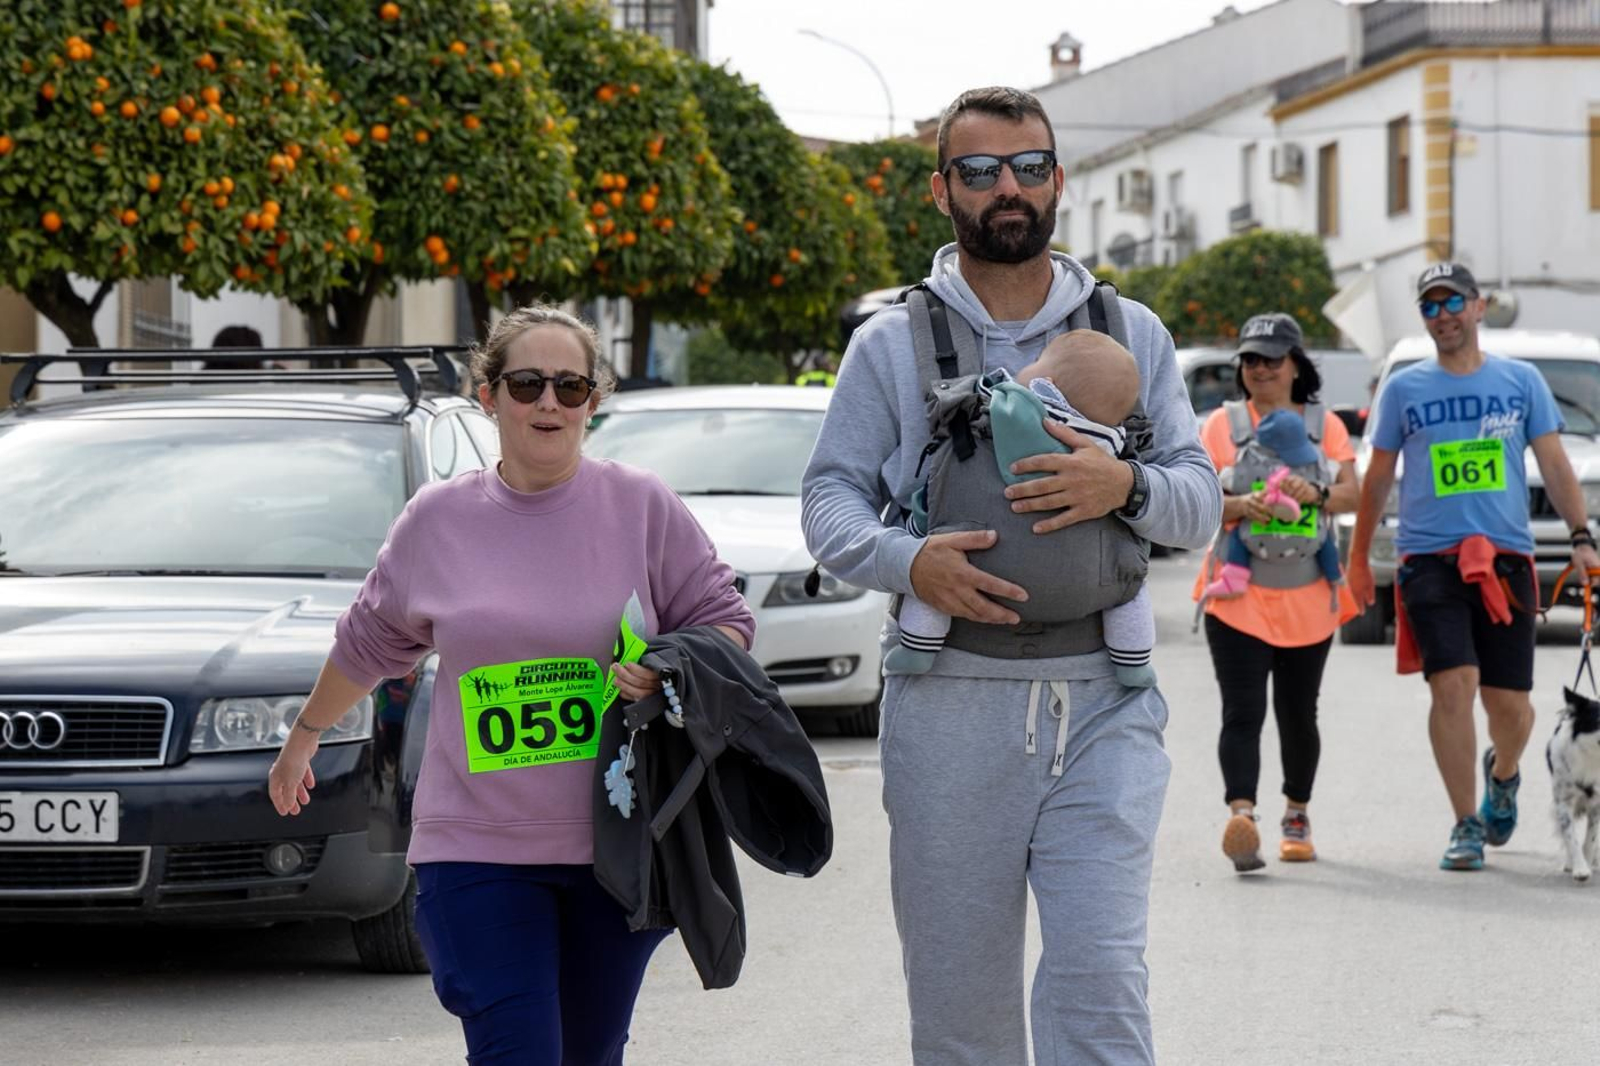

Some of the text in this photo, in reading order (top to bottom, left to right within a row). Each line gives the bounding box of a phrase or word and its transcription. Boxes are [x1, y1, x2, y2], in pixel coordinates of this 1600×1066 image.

[1402, 395, 1526, 439] ADIDAS
[1441, 458, 1497, 487] 061
[514, 670, 596, 686] RUNNING
[520, 662, 588, 674] CIRCUITO
[518, 682, 595, 697] Monte Lope Álvarez
[603, 685, 617, 706] ANDA
[477, 697, 596, 755] 059
[503, 748, 581, 766] DÍA DE ANDALUCÍA
[34, 799, 108, 833] CCY
